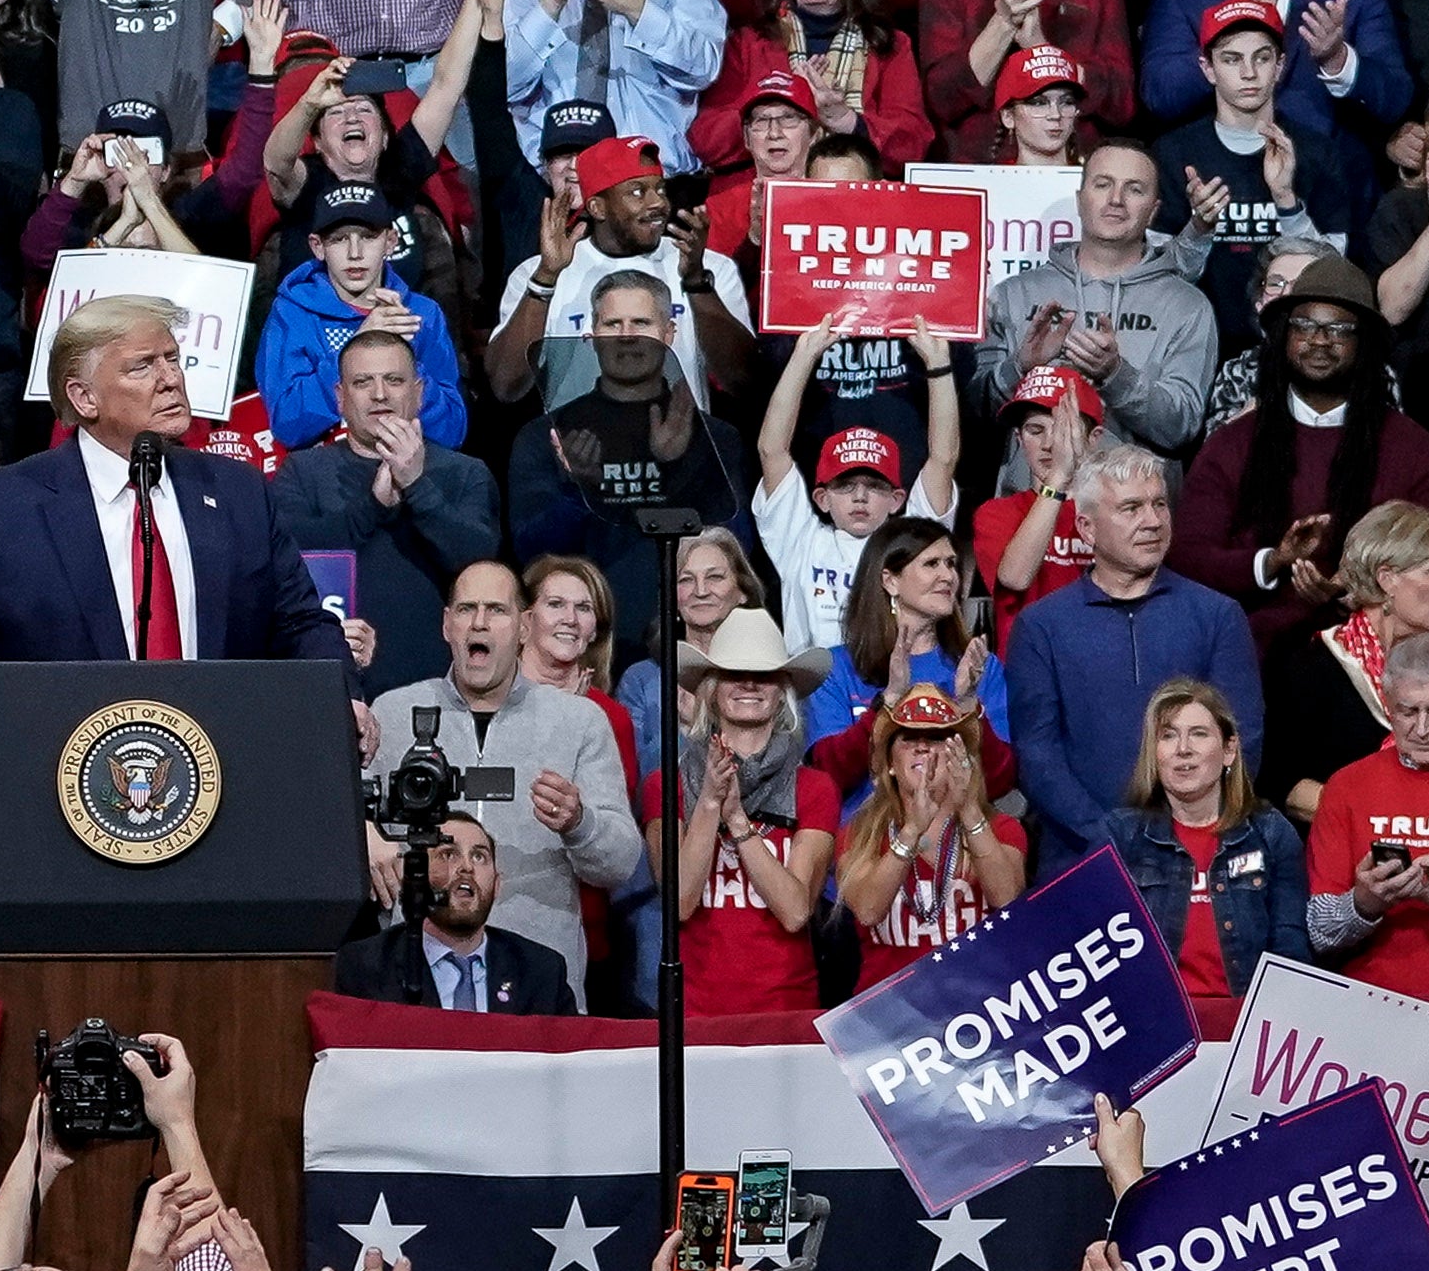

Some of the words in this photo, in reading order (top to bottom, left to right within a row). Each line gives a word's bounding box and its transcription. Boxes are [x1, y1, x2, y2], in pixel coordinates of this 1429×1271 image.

[550, 106, 603, 122] TRUMP
[782, 223, 970, 257] TRUMP
[799, 255, 952, 280] PENCE
[811, 279, 841, 292] KEEP
[842, 280, 894, 293] AMERICA
[895, 281, 936, 295] GREAT!
[860, 325, 885, 337] 2020
[160, 712, 181, 730] THE
[63, 706, 138, 777] PRESIDENT
[183, 728, 216, 794] UNITED
[65, 782, 77, 805] THE
[84, 820, 125, 855] SEAL
[152, 807, 209, 855] STATES
[864, 910, 1146, 1106] PROMISES
[955, 994, 1130, 1123] MADE
